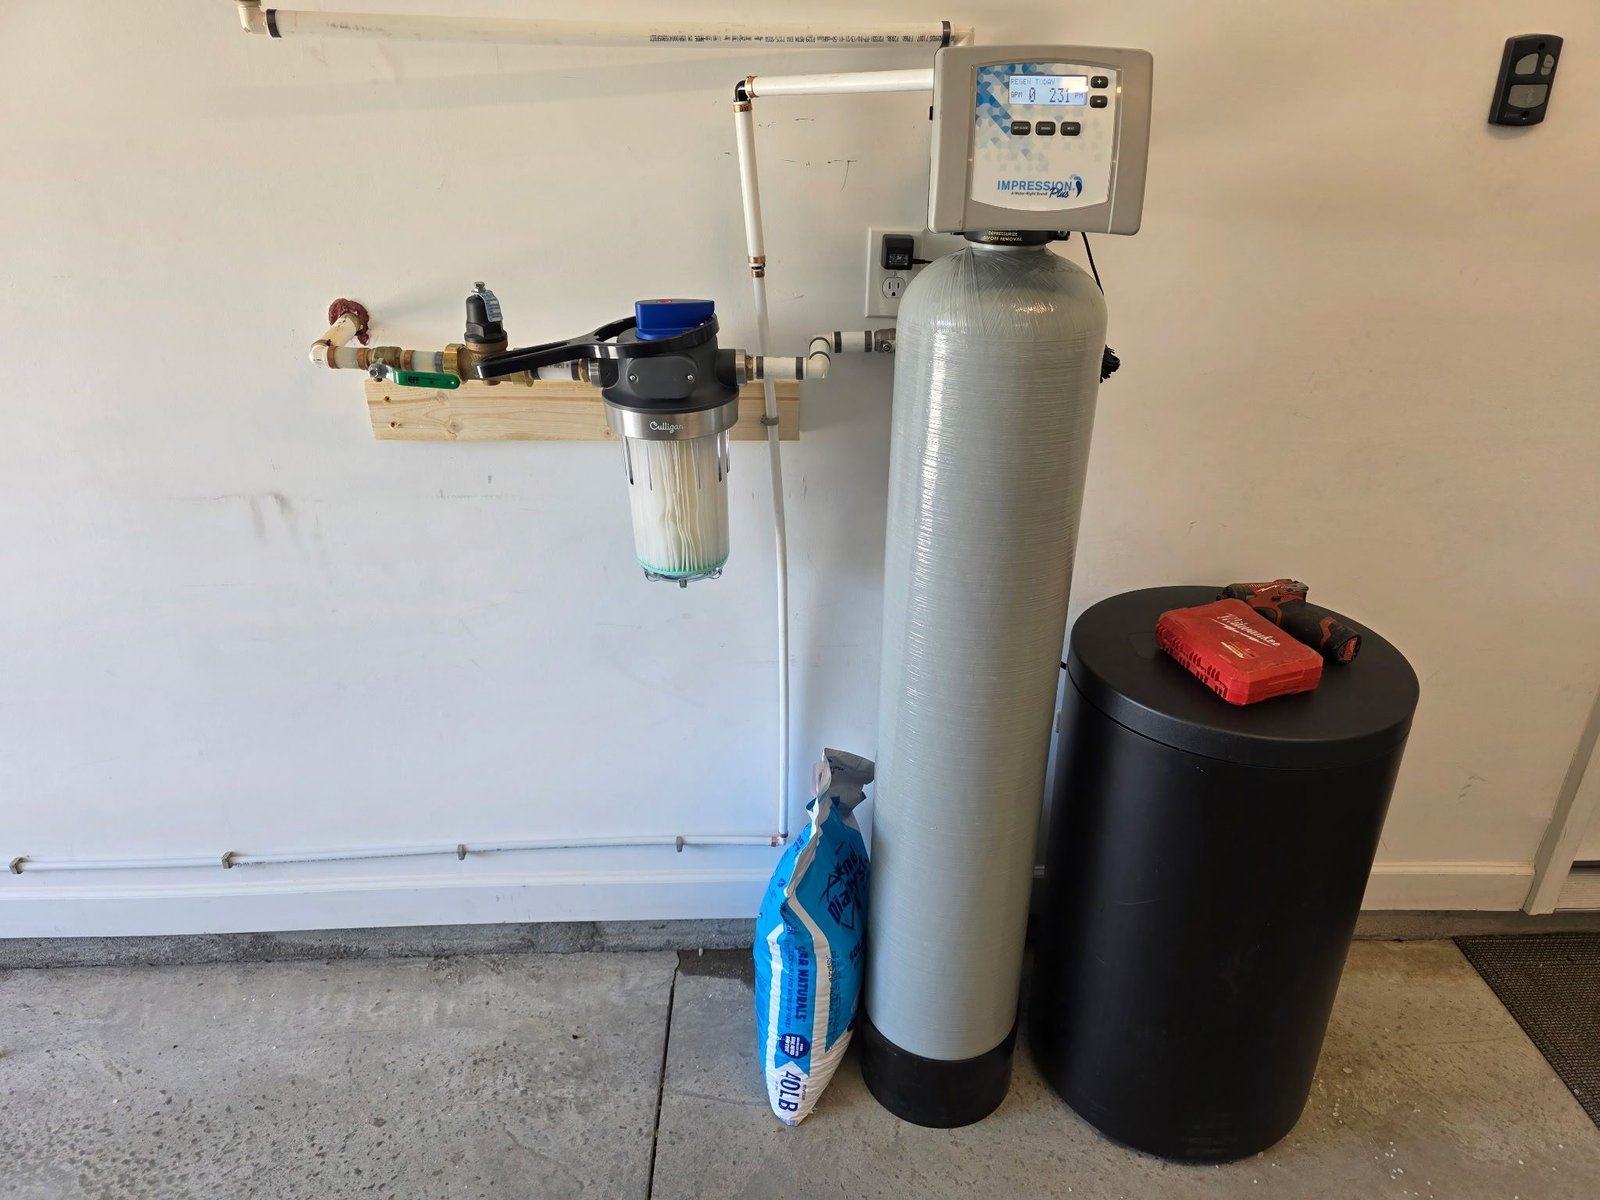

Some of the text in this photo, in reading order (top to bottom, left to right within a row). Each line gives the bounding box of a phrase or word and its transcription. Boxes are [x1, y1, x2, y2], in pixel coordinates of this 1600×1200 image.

[1035, 78, 1056, 86] TODAY
[997, 179, 1073, 191] IMPRESSION
[1049, 186, 1070, 199] Plus
[649, 420, 684, 434] Culligan
[1217, 612, 1281, 647] Milwaukee
[795, 968, 810, 1020] NATURALS
